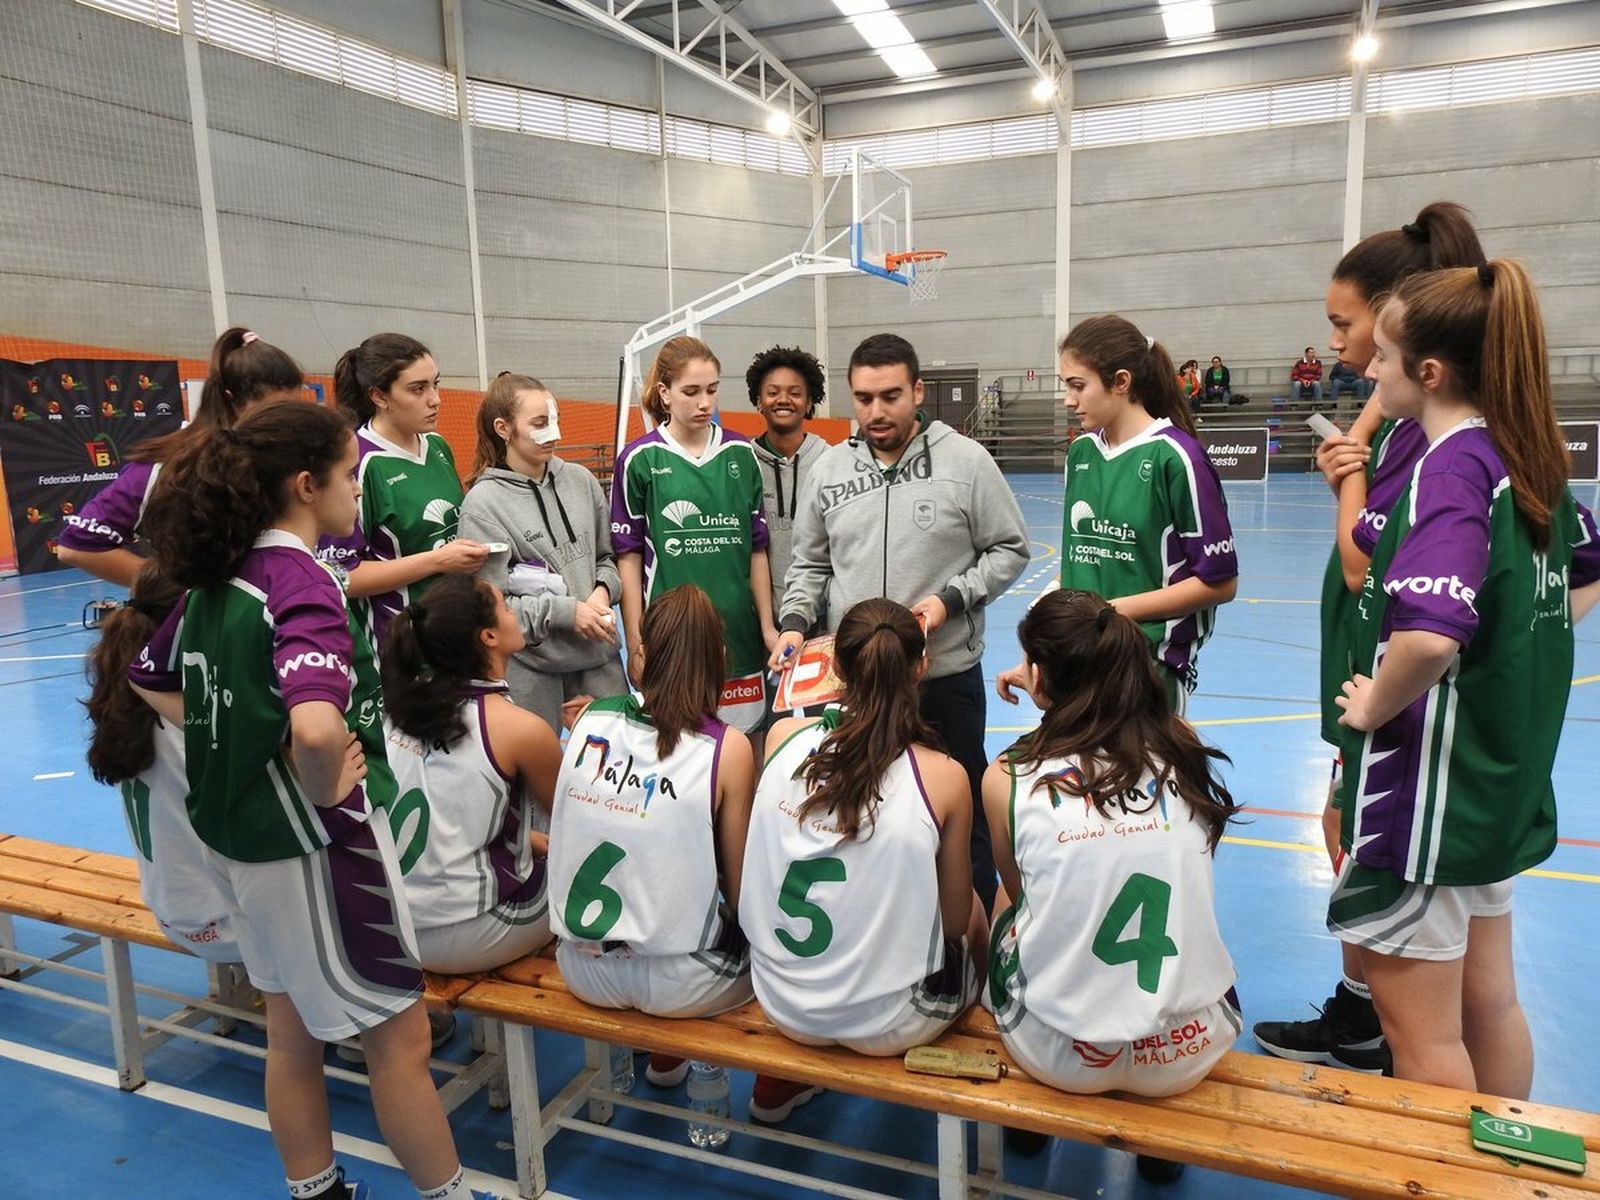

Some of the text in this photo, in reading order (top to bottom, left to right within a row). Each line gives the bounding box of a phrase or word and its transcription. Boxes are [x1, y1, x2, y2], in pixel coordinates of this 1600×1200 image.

[1206, 444, 1258, 454] Andaluza
[1210, 457, 1239, 467] cesto
[38, 472, 119, 486] Federación Andaluza
[820, 453, 932, 513] SPALDNG
[69, 515, 123, 544] orten
[684, 538, 712, 547] COSTA
[712, 536, 731, 545] DEL
[1091, 519, 1136, 541] Unicaja
[1114, 550, 1135, 562] SOL
[1203, 536, 1233, 557] wor
[1382, 575, 1479, 617] worte
[1057, 826, 1106, 844] Ciudad
[564, 841, 628, 941] 6
[774, 857, 847, 958] 5
[1091, 872, 1179, 994] 4
[1170, 1019, 1208, 1045] SOL
[1133, 1036, 1211, 1066] MÁLAGA
